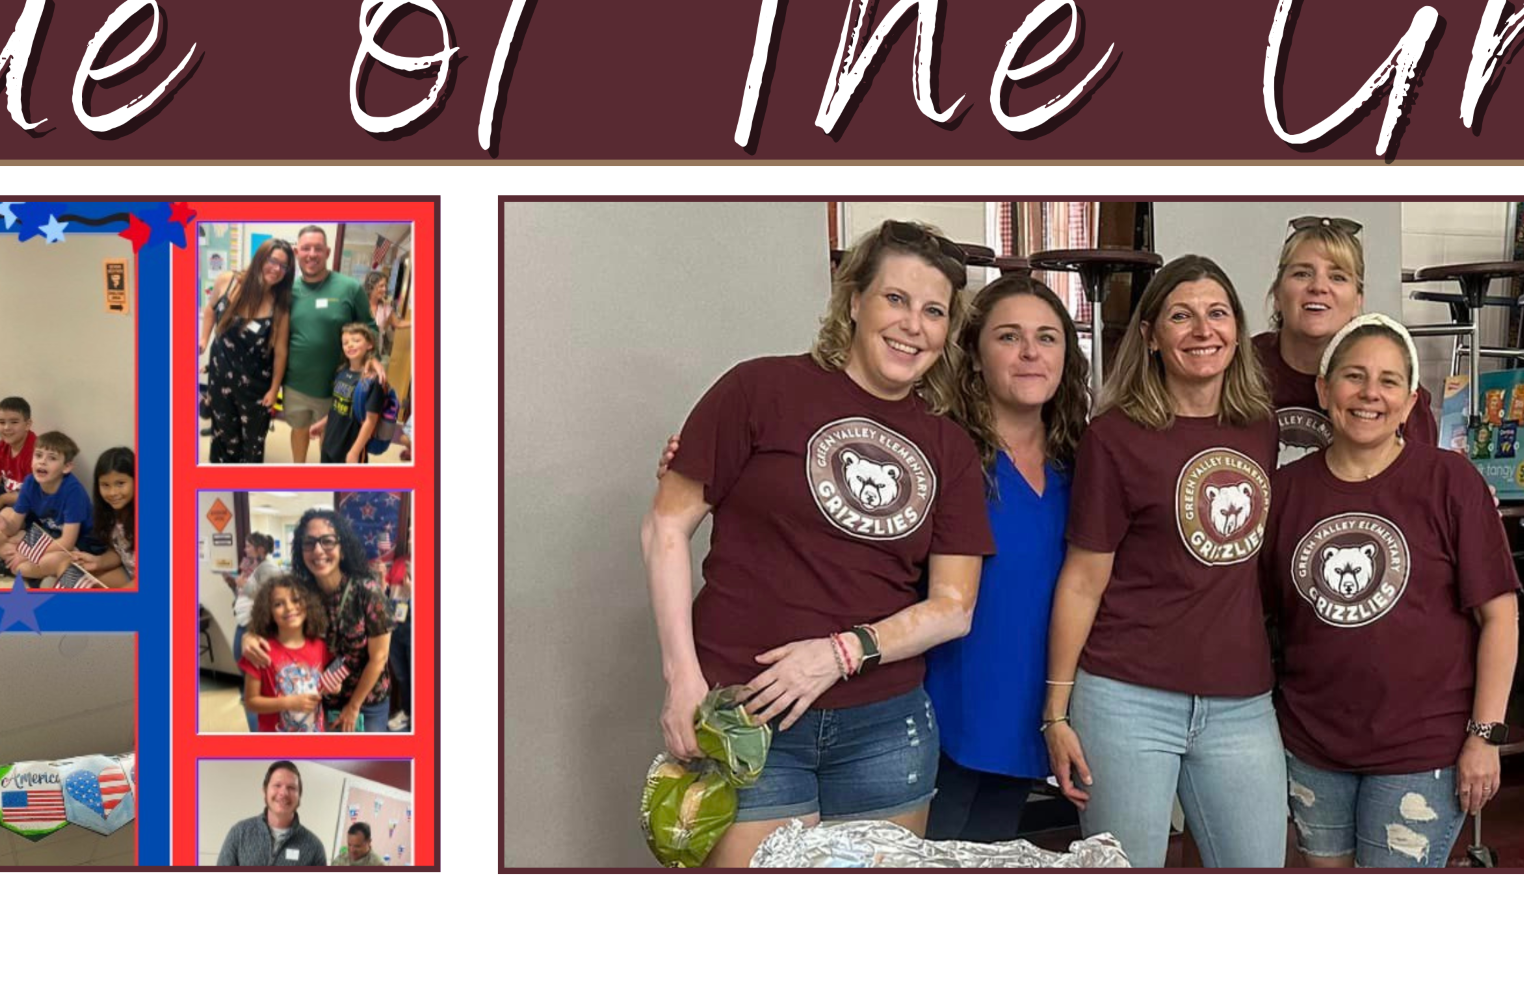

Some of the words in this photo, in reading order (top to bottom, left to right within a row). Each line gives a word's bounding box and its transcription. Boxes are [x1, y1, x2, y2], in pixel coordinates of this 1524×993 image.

[832, 428, 877, 441] VALLEY
[879, 435, 928, 500] ELEMENTARY
[1190, 457, 1222, 479] VALLEY
[1487, 464, 1515, 479] tangy
[818, 480, 918, 535] GRIZZLIES
[1185, 480, 1197, 520] GREEN
[1299, 540, 1316, 578] GREEN
[1315, 520, 1356, 540] VALLEY
[1358, 520, 1401, 573] ELEMENTARY
[1309, 581, 1395, 622] GRIZZLIES
